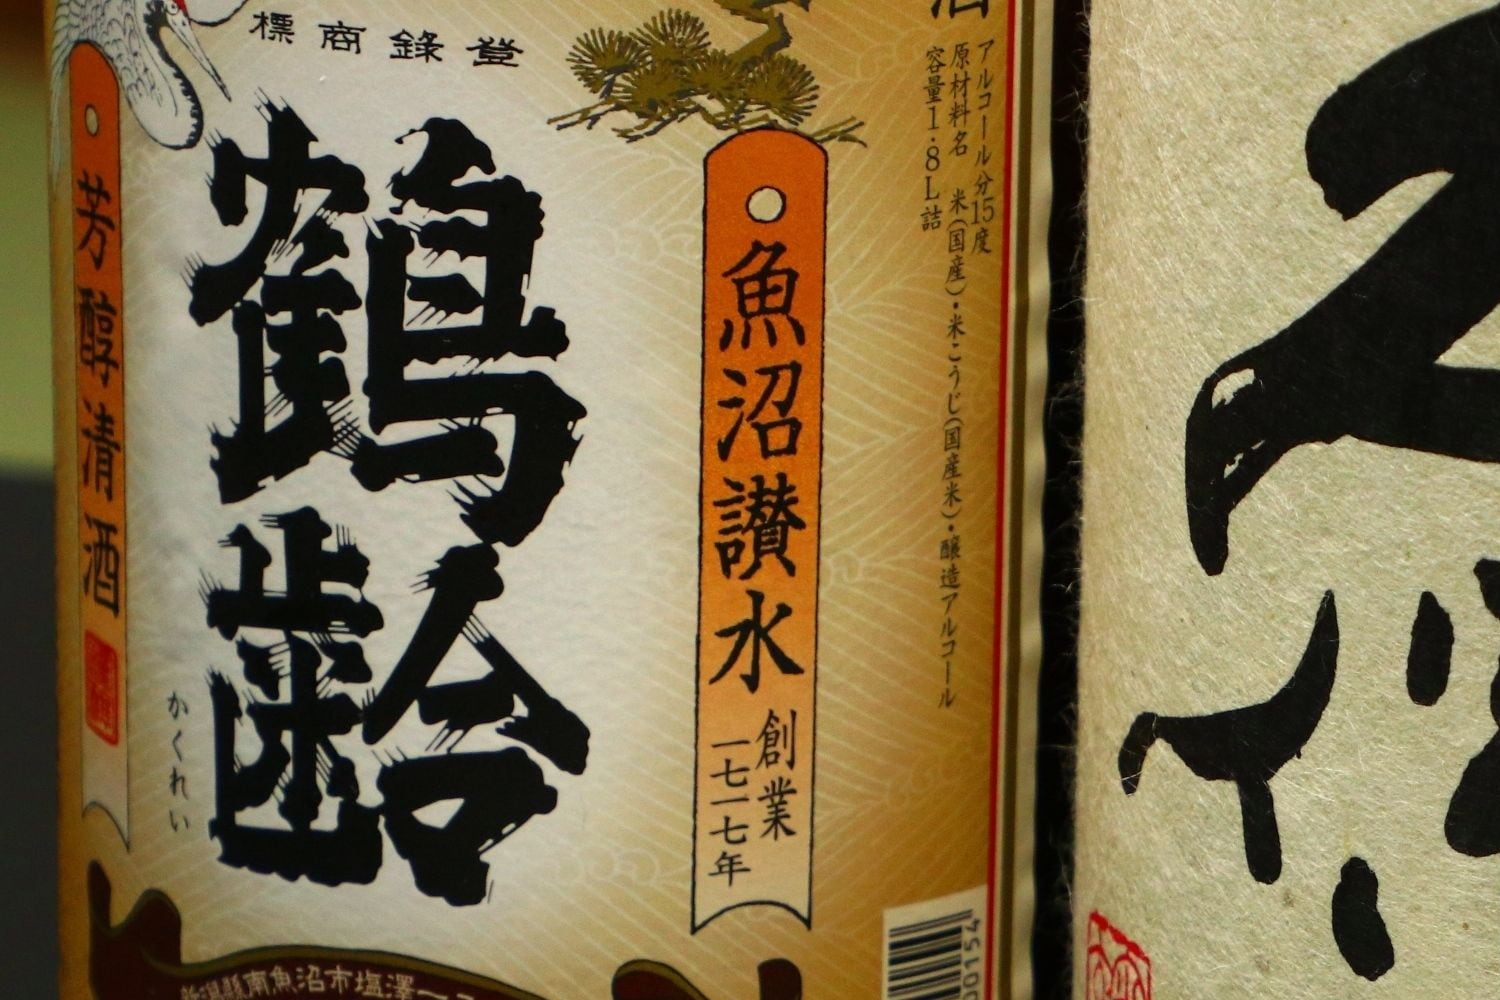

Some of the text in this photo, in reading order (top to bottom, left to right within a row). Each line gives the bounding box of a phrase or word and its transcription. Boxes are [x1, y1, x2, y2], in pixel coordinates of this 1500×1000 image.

[948, 41, 972, 157] 原材料名
[971, 39, 995, 255] アルコール分15度
[75, 171, 121, 618] 芳醇清酒
[167, 690, 190, 833] かくれい
[755, 708, 798, 839] 創業
